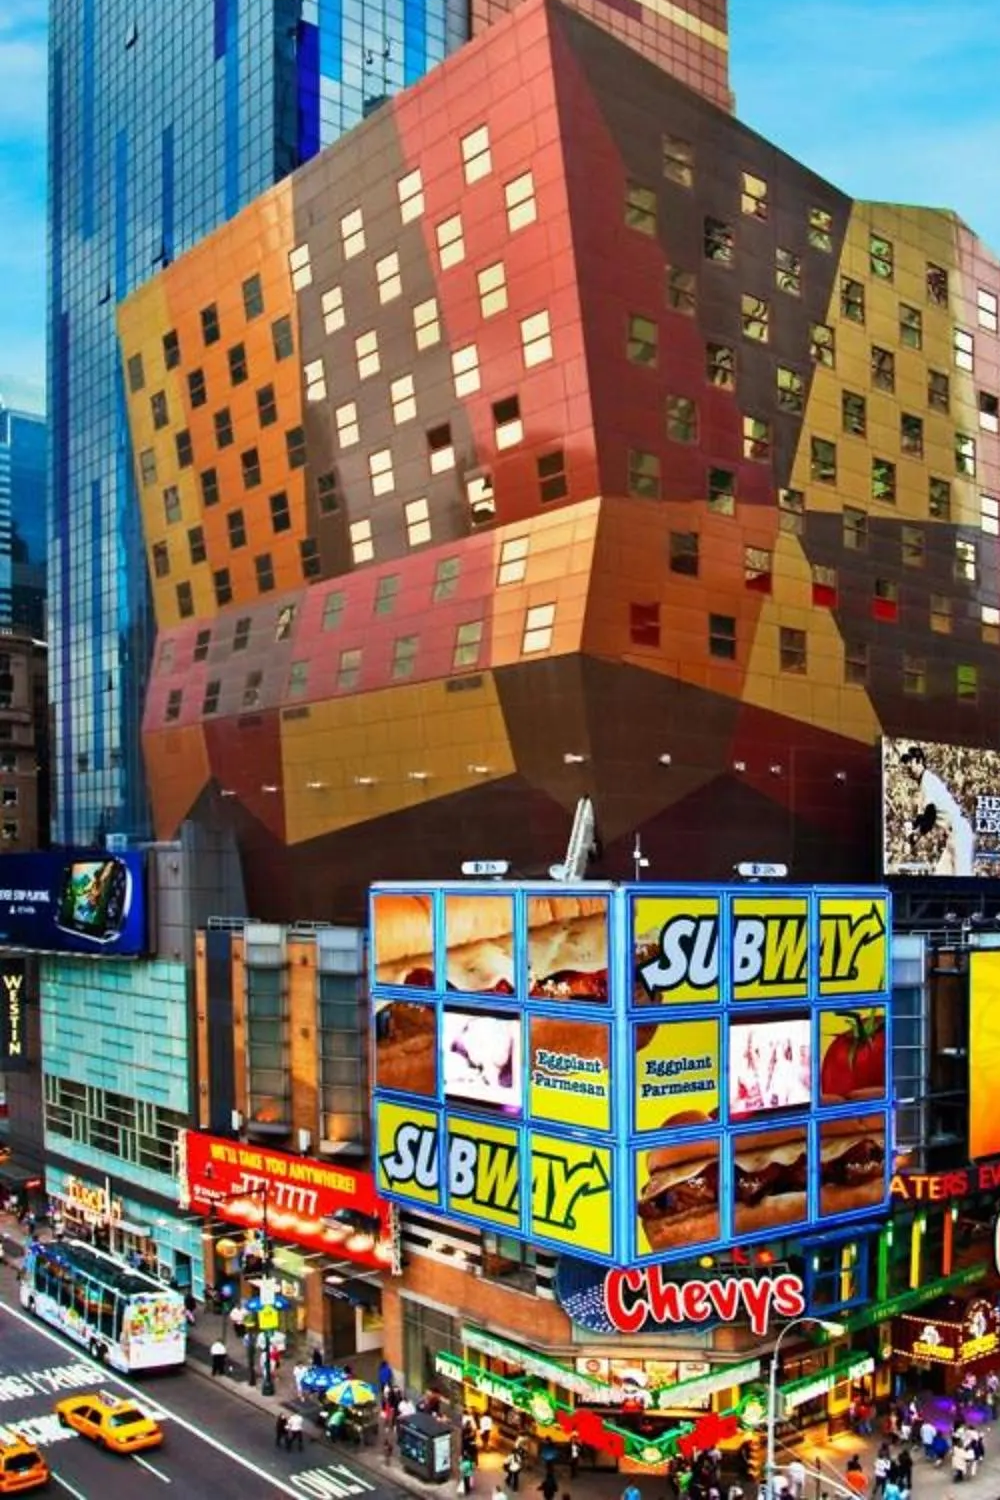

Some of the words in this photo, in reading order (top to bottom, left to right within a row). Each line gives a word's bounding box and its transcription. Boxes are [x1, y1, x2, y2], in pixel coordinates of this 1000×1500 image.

[639, 903, 885, 993] SUBWAY
[3, 974, 23, 1055] WESTIN
[536, 1050, 602, 1074] Eggplant
[645, 1056, 712, 1077] Eggplant
[533, 1072, 606, 1097] Parmesan
[641, 1079, 716, 1098] Parmesan
[238, 1150, 263, 1170] TAKE
[265, 1156, 287, 1176] YOU
[288, 1162, 356, 1194] ANYWHERE!
[379, 1121, 611, 1230] SUBWAY
[604, 1264, 805, 1337] Chevys
[290, 1464, 375, 1500] ONLY
